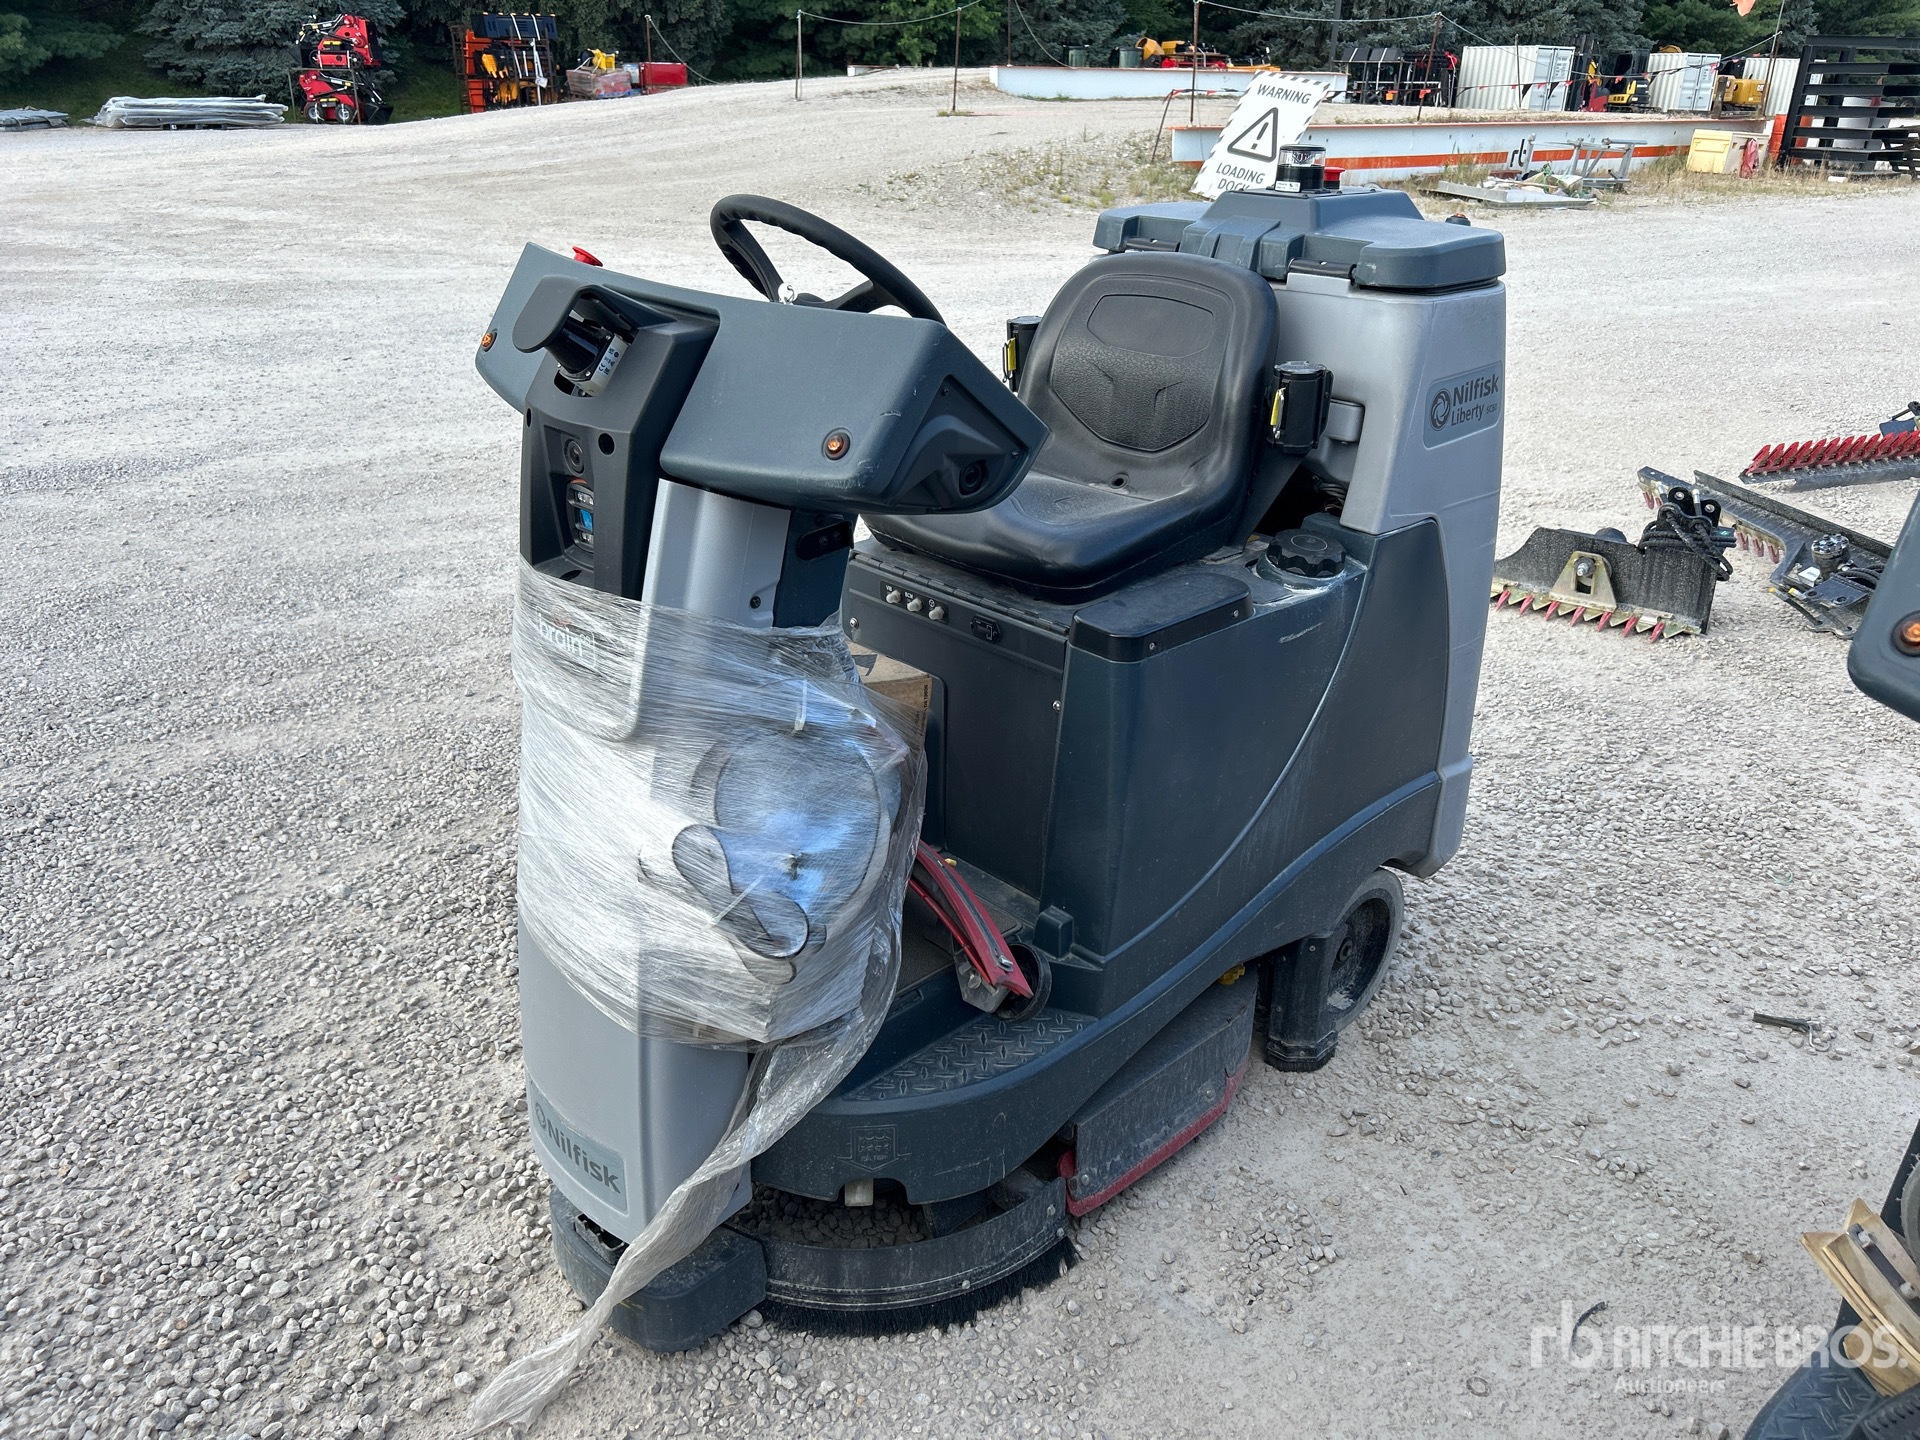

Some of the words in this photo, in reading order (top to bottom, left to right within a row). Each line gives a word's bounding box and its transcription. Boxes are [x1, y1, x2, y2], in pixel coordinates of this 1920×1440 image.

[1257, 84, 1311, 104] WARNING
[1216, 162, 1266, 184] LOADING
[1453, 374, 1499, 407] Nilfisk
[1451, 404, 1485, 426] Liberty
[547, 1117, 621, 1194] Nilfisk
